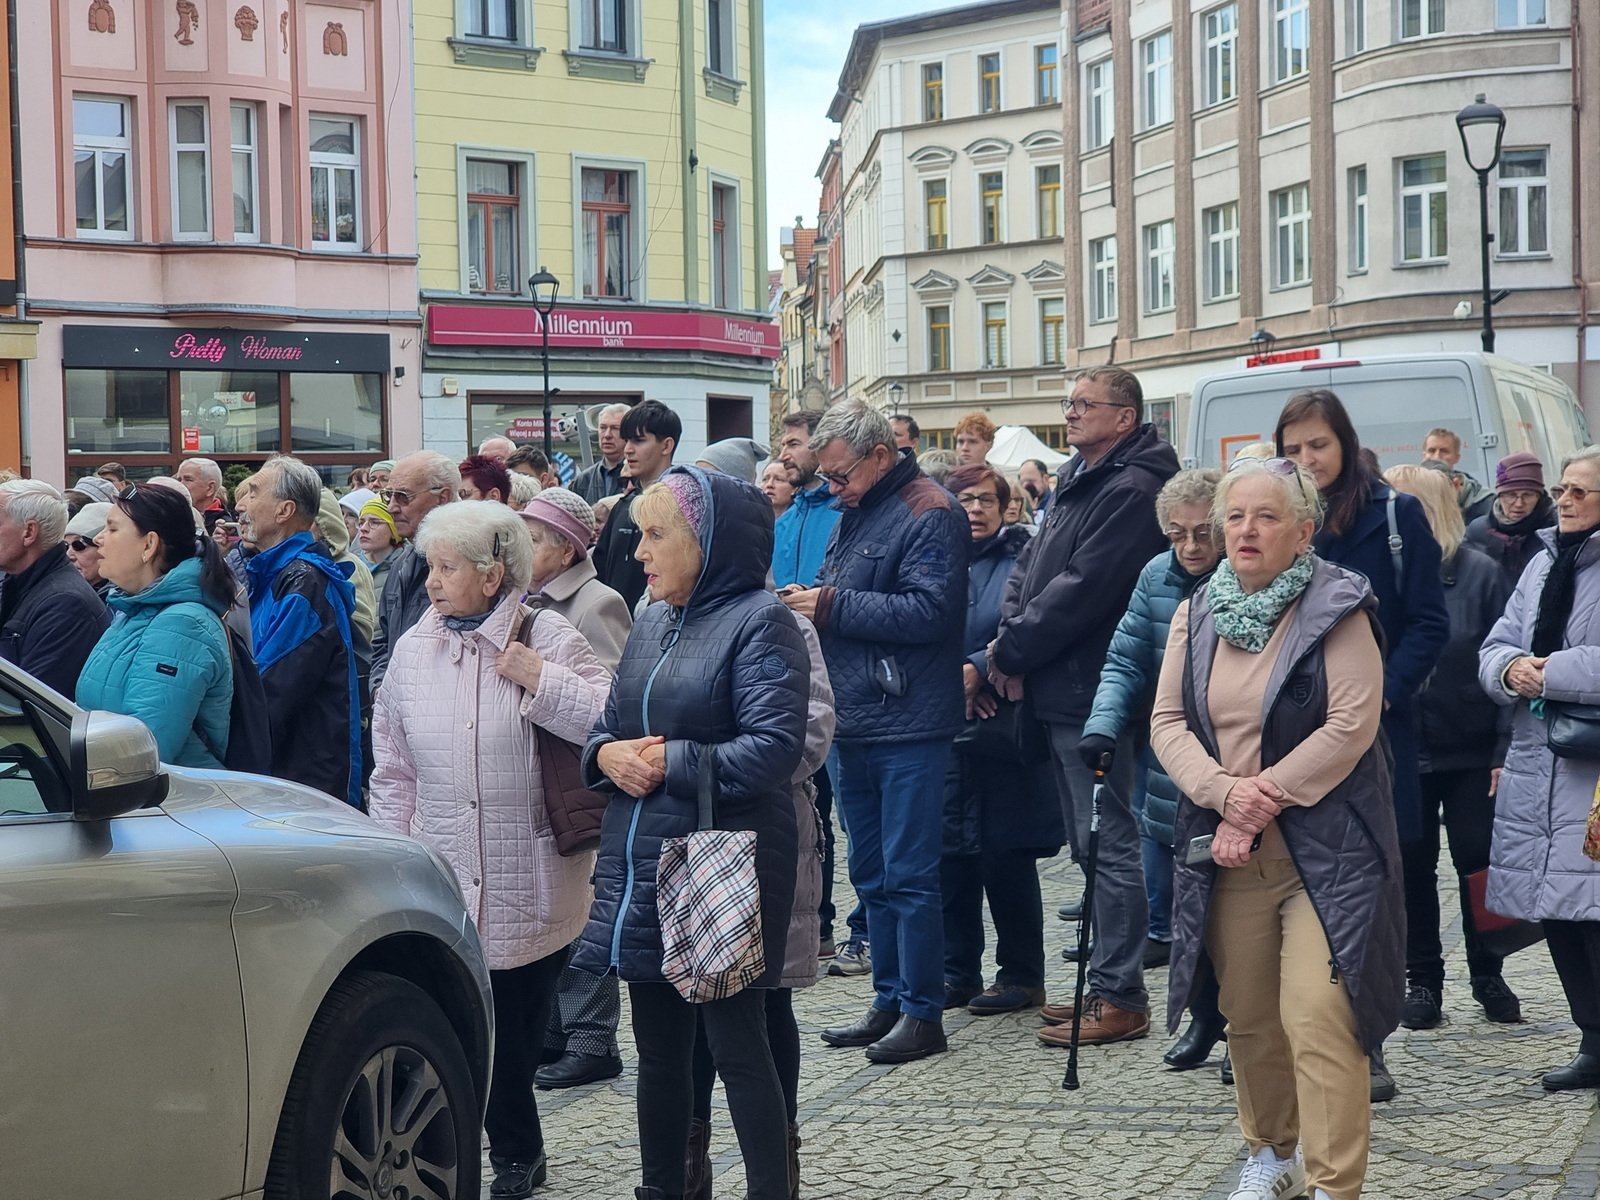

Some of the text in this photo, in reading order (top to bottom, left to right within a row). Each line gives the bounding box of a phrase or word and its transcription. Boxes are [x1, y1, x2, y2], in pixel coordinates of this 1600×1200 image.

[534, 309, 633, 335] Millennium
[724, 318, 765, 345] Millennium
[169, 333, 302, 363] Pretty Woman
[602, 336, 624, 347] bank
